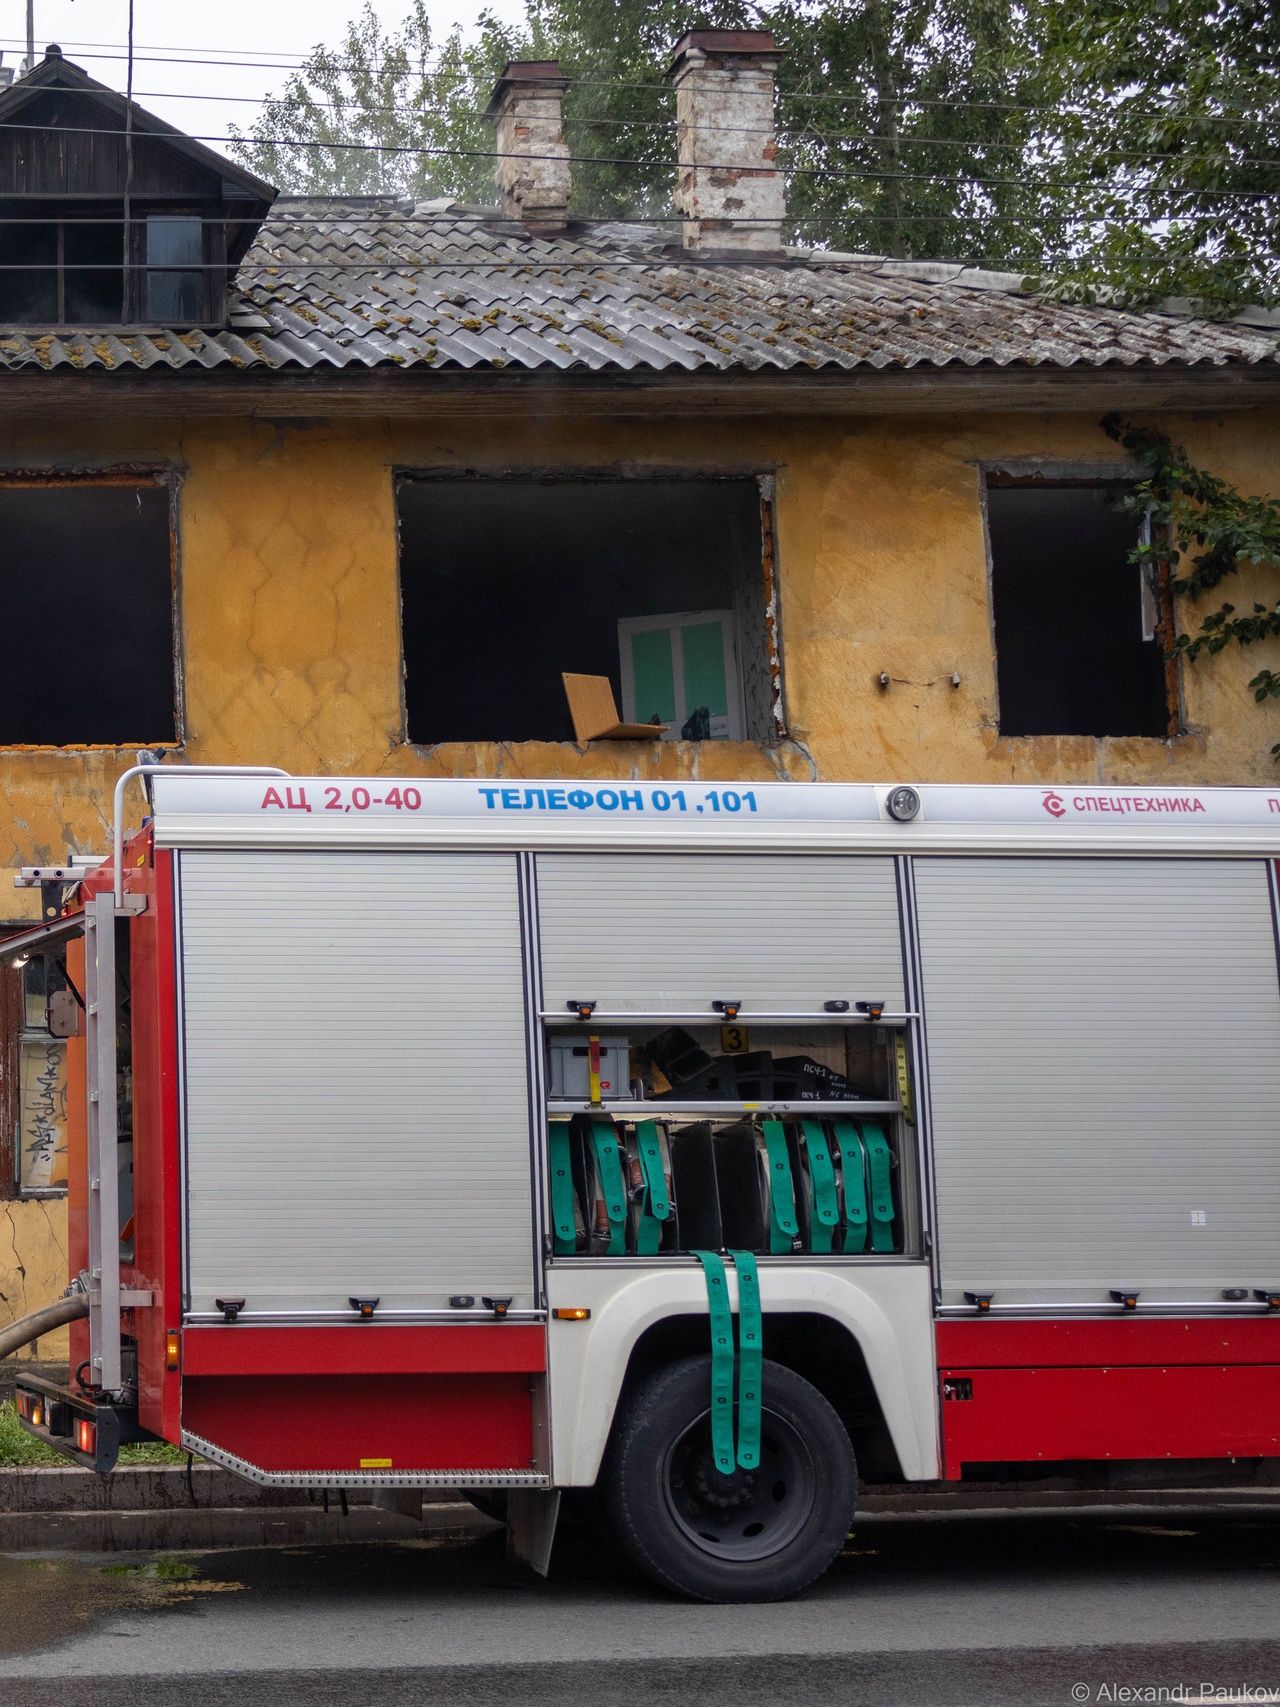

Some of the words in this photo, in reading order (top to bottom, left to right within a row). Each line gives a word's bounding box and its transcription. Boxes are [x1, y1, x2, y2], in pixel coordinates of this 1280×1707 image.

[261, 787, 312, 812] АЦ
[324, 787, 422, 813] 2,0-40
[478, 788, 644, 810] ТЕЛЕФОН
[1073, 797, 1206, 814] СПЕЦТЕХНИКА
[728, 1028, 743, 1050] 3
